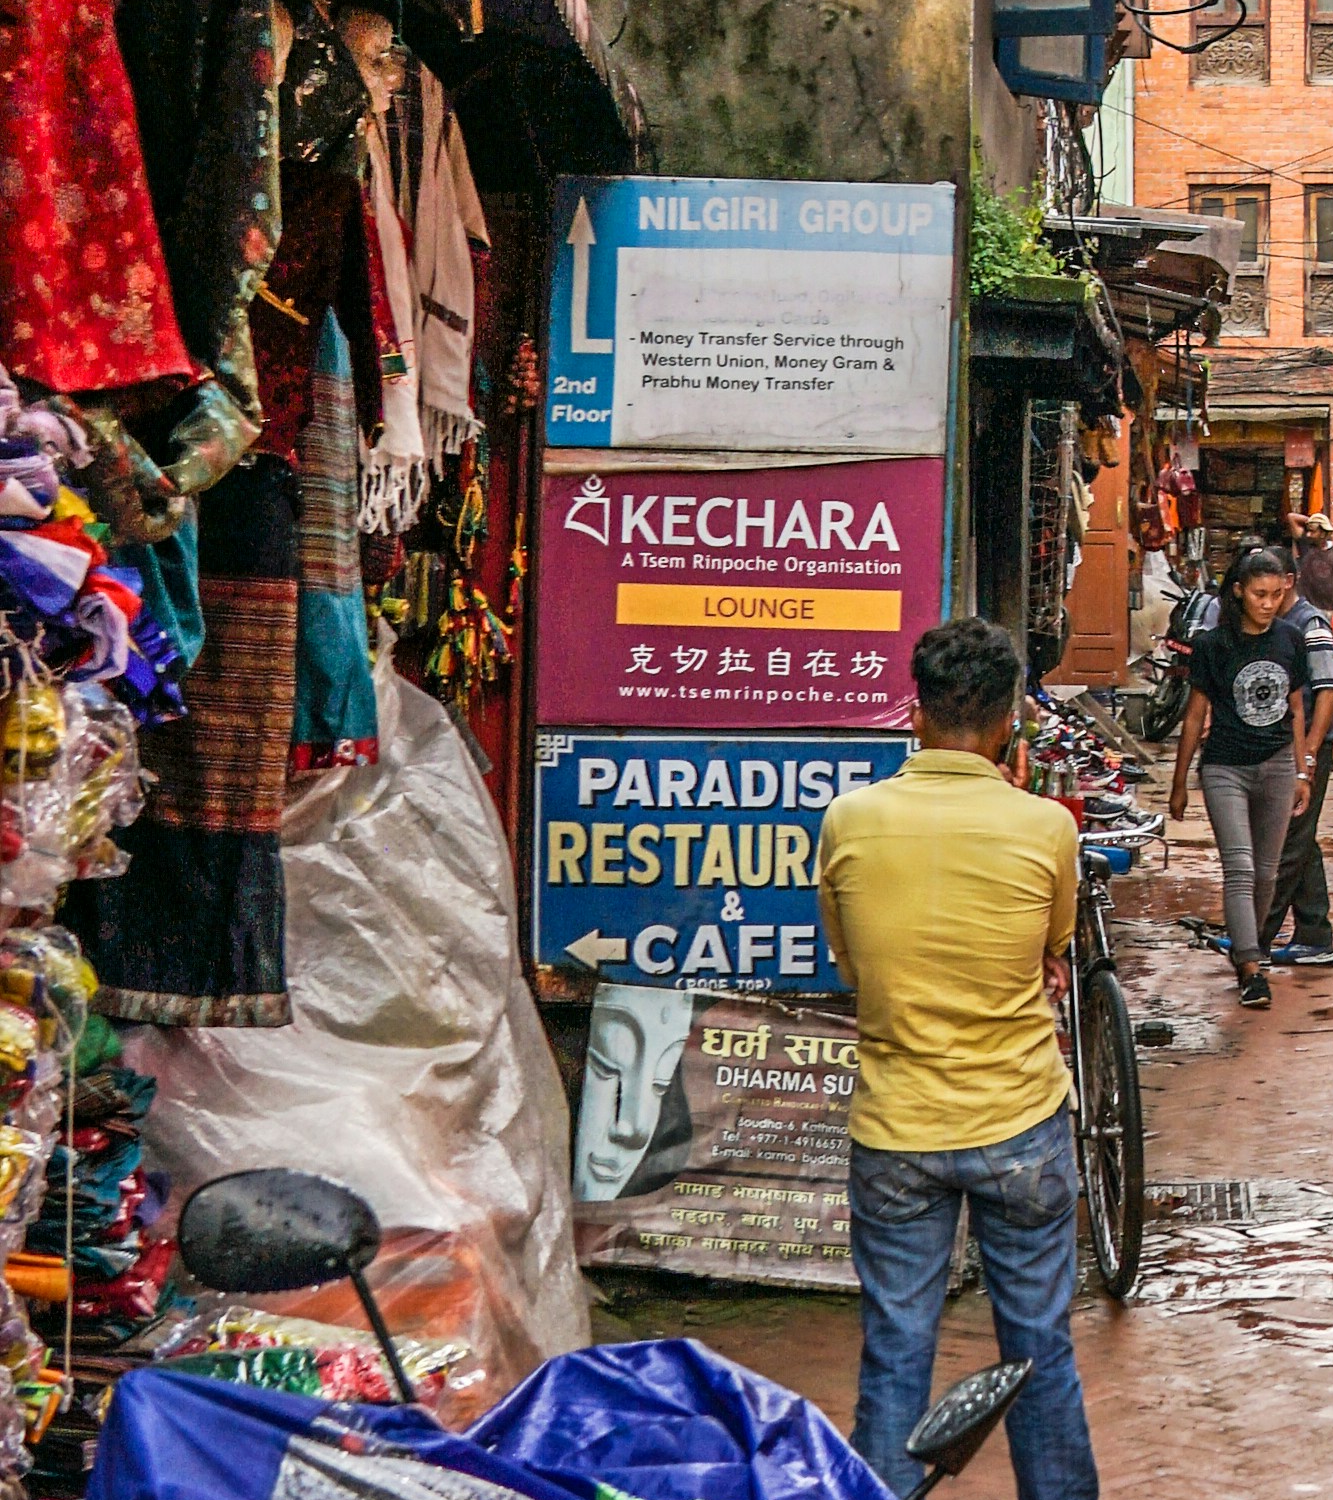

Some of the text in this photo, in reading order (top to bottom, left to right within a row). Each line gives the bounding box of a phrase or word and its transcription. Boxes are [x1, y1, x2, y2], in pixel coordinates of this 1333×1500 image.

[638, 196, 934, 236] NILGIRI GROUP
[640, 331, 904, 351] Money Transfer Service through
[642, 354, 895, 372] Western Union, Money Gram &
[553, 377, 596, 394] 2nd
[642, 375, 834, 392] Prabhu Money Transfer
[551, 405, 611, 423] Floor
[621, 494, 901, 552] KECHARA
[621, 552, 901, 576] A Tsem Rinpoche Organisation
[703, 597, 814, 619] LOUNGE
[619, 683, 888, 704] www.tsemrinpoche.com
[578, 758, 871, 809] PARADISE
[547, 821, 821, 886] RESTAUR
[721, 890, 744, 921] &
[633, 924, 815, 975] CAFE
[735, 978, 772, 990] TOP)
[701, 1025, 771, 1061] धर्म
[716, 1066, 817, 1093] DHARMA
